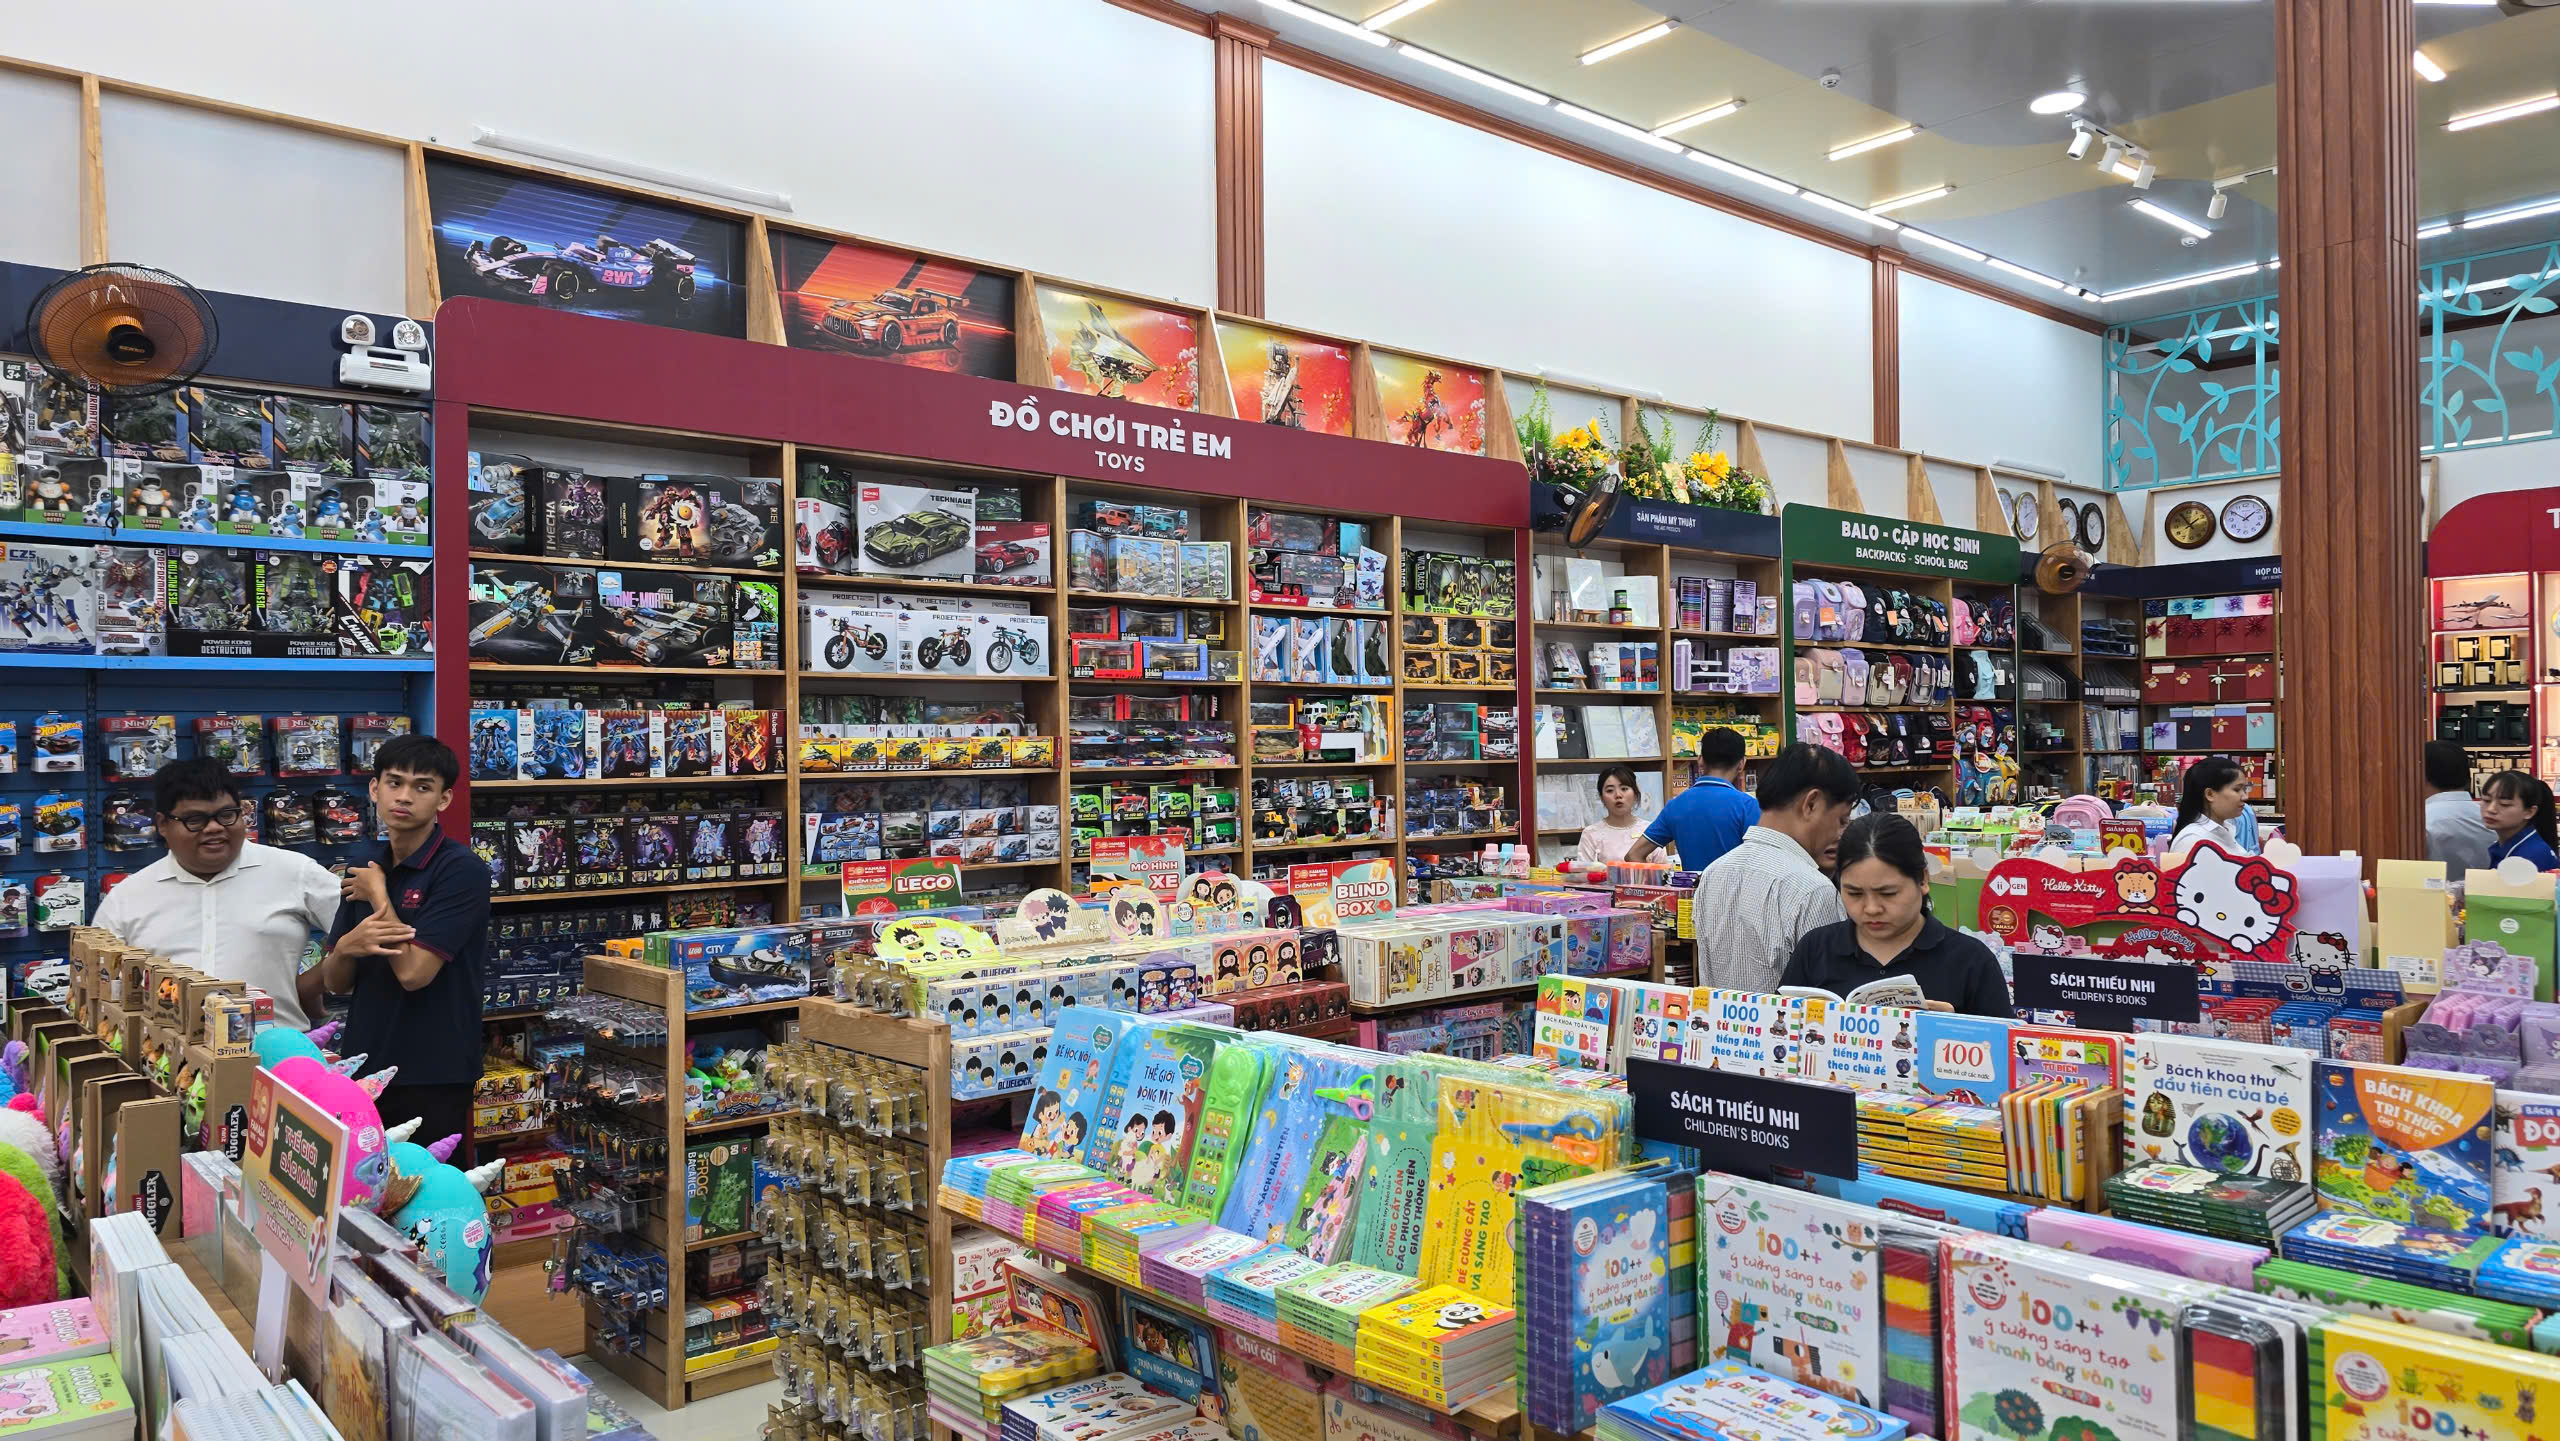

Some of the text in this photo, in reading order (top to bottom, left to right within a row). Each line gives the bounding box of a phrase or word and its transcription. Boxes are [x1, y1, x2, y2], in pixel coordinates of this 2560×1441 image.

[6, 370, 21, 381] 3+
[989, 395, 1231, 459] ĐỒ CHƠI TRẺ EM
[1095, 451, 1144, 471] TOYS
[1842, 521, 1879, 541] BALO
[1893, 524, 1919, 550] CẶP
[1923, 533, 1949, 554] HỌC
[1953, 537, 1979, 554] SINH
[1856, 547, 1968, 570] BACKPACKS SCHOOL BAGS
[167, 559, 178, 605] DESTRUCTION
[256, 563, 266, 609] DESTRUCTION
[340, 615, 379, 654] CHANGE
[201, 646, 252, 655] DESTRUCTION
[288, 647, 336, 656] DESTRUCTION
[1131, 860, 1178, 871] MÔ HÌNH
[897, 876, 951, 891] LEGO
[1150, 874, 1178, 889] XE
[1337, 883, 1387, 899] BLIND
[2041, 878, 2105, 898] Hello Kitty
[1337, 901, 1375, 917] BOX
[825, 929, 853, 937] SPEED
[2124, 928, 2195, 953] Hello Kitty
[705, 945, 724, 954] CITY
[2051, 972, 2155, 993] SÁCH THIẾU NHI
[2062, 990, 2147, 1006] CHILDREN'S BOOKS
[1723, 1004, 1759, 1023] 1000
[1840, 1015, 1880, 1035] 1000
[1541, 1026, 1598, 1052] CHO BÉ
[1716, 1019, 1762, 1037] từ vựng
[1711, 1045, 1764, 1061] theo chủ đề
[1716, 1033, 1761, 1050] tiếng Anh
[1833, 1032, 1883, 1050] từ vựng
[1055, 1044, 1091, 1064] BÉ HỌC NÓI
[1833, 1047, 1882, 1064] tiếng Anh
[1942, 1042, 1984, 1067] 100
[1828, 1059, 1886, 1076] theo chủ đề
[2166, 1063, 2277, 1088] Bách khoa thư
[1137, 1085, 1174, 1107] ĐỘNG VẬT
[2153, 1076, 2289, 1106] đầu tiên của bé
[2365, 1075, 2464, 1128] BÁCH KHOA
[1671, 1091, 1800, 1131] SÁCH THIẾU NHI
[2374, 1100, 2445, 1136] TRI THỨC
[226, 1106, 242, 1160] FUGGLER
[1685, 1117, 1790, 1150] CHILDREN'S BOOKS
[300, 1140, 318, 1168] GIỚI
[1257, 1176, 1272, 1207] SÁCH
[1266, 1153, 1280, 1176] ĐẦU
[1274, 1126, 1290, 1153] TIÊN
[687, 1152, 696, 1199] BALANCE
[697, 1157, 708, 1196] FROG
[1386, 1170, 1405, 1256] CÙNG CẮT DÁN
[1396, 1159, 1417, 1272] CÁC PHƯƠNG TIỆN
[1410, 1179, 1425, 1256] GIAO THÔNG
[1458, 1200, 1477, 1285] BÉ CÙNG CẮT
[1471, 1200, 1491, 1291] VÀ SÁNG TẠO
[1757, 1226, 1822, 1264] 100++
[1261, 1258, 1302, 1278] mẹ hỏi
[1731, 1253, 1843, 1292] ý tưởng sáng tạo
[1253, 1277, 1269, 1288] Bé
[1333, 1271, 1375, 1294] mẹ hỏi
[1331, 1292, 1349, 1305] Bé
[1719, 1269, 1732, 1281] vẽ
[1736, 1272, 1769, 1291] tranh
[1837, 1301, 1862, 1322] tay
[2018, 1291, 2104, 1338] 100++
[1235, 1334, 1276, 1365] Chữ cái
[1984, 1318, 2131, 1369] ý tưởng sáng tạo
[1968, 1335, 1984, 1349] vẽ
[1988, 1339, 2031, 1363] tranh
[2120, 1378, 2153, 1404] tay
